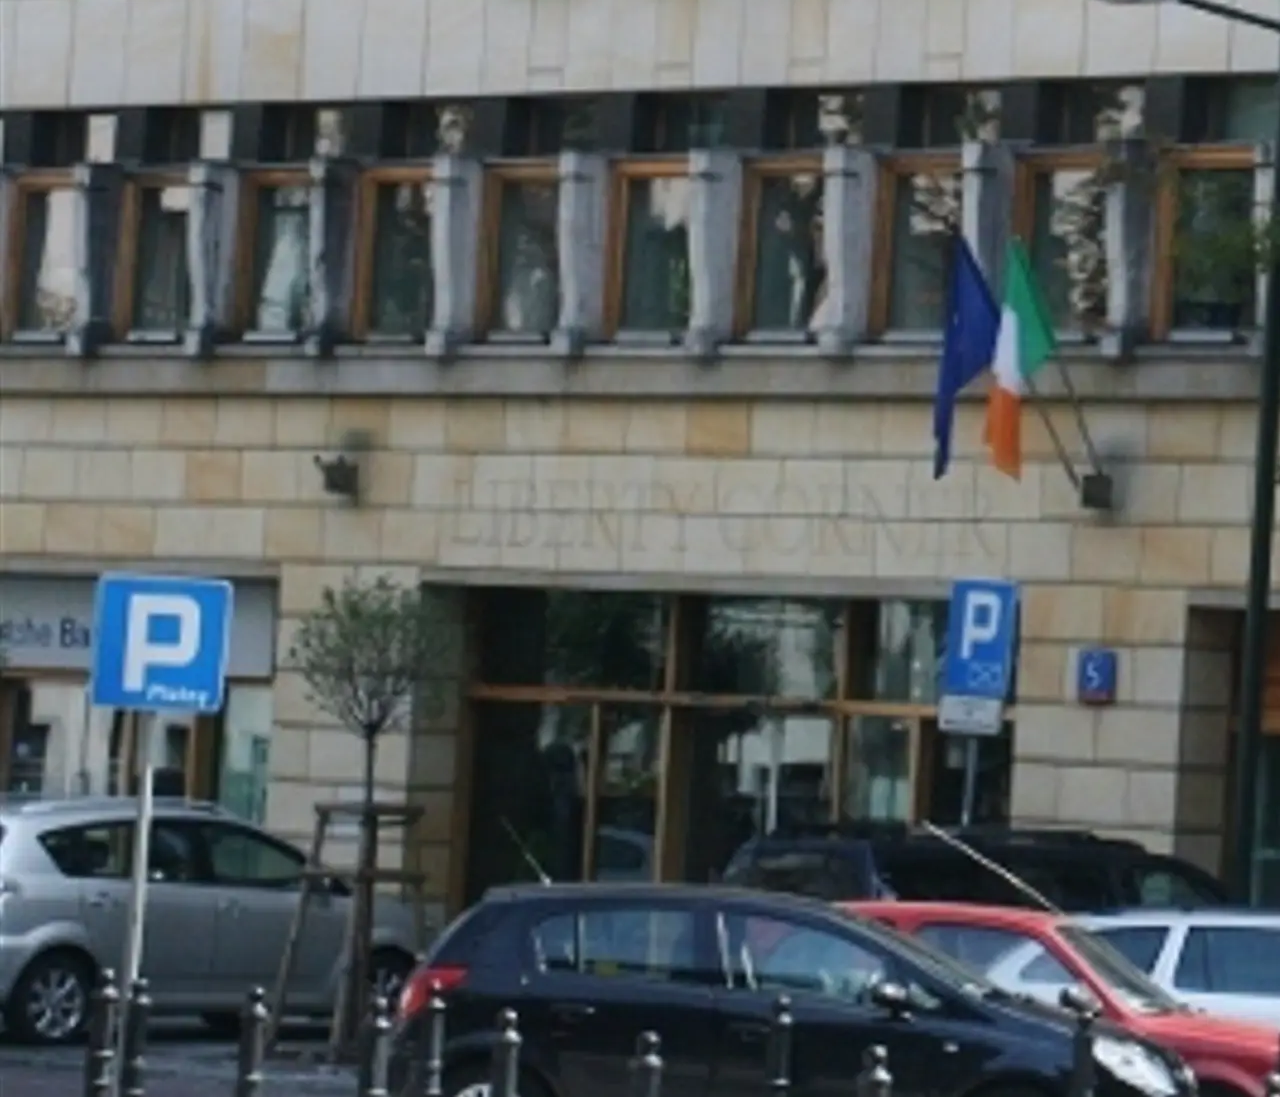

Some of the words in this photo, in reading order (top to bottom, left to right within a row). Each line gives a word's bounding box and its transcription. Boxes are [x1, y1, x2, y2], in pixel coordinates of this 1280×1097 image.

[450, 477, 697, 552] LIBERTY
[715, 481, 1003, 560] CORNER
[60, 618, 90, 648] Ba
[122, 593, 200, 693] P
[960, 591, 1001, 660] P
